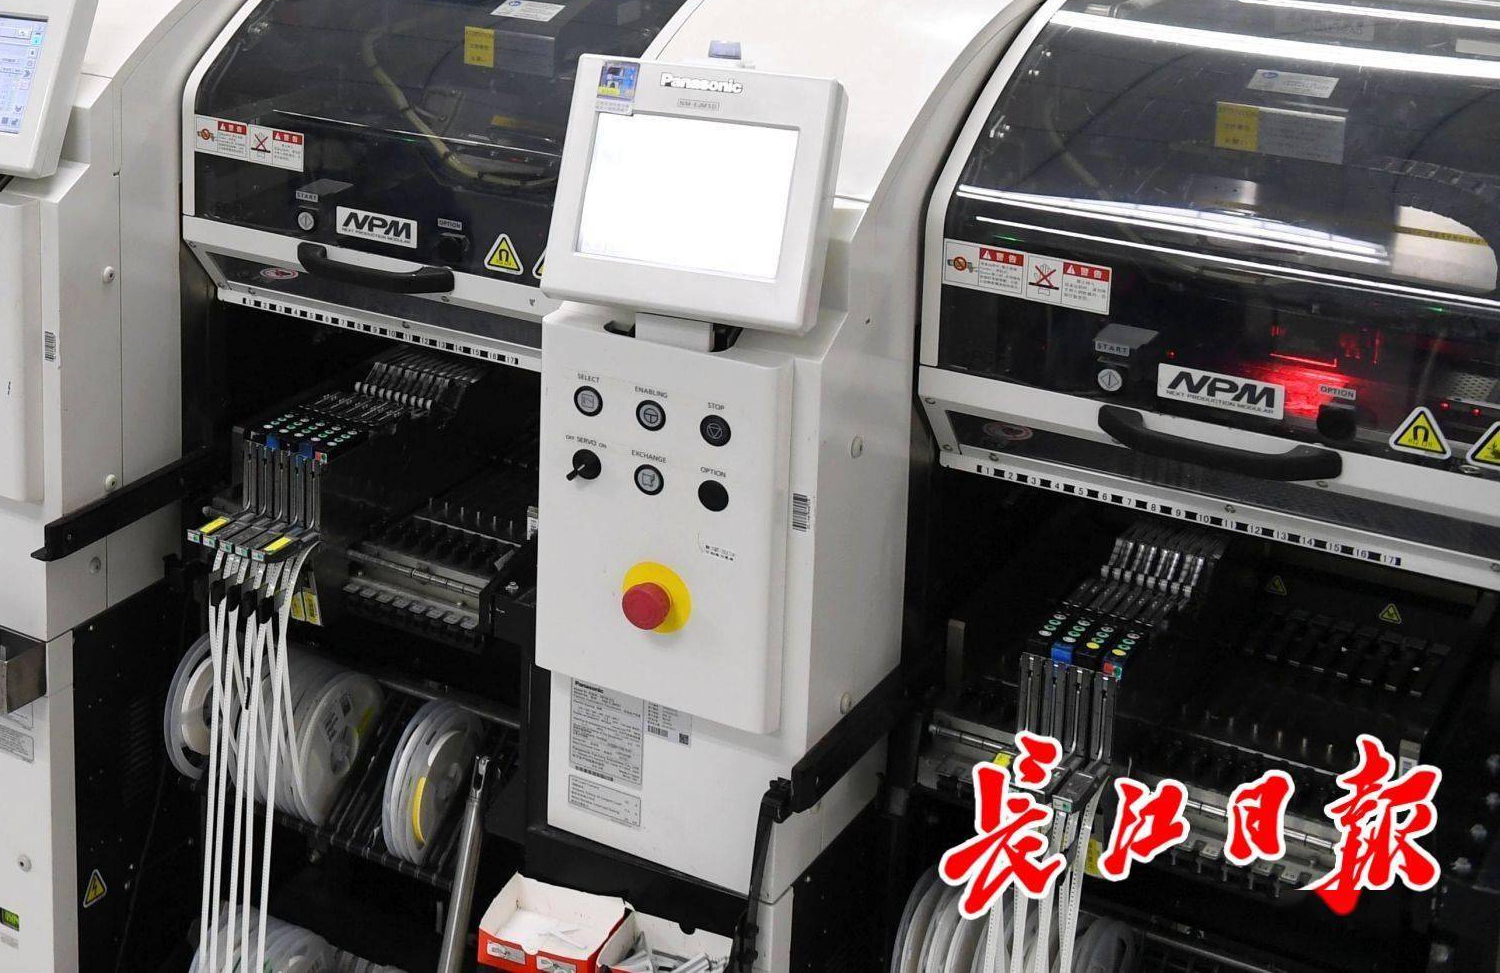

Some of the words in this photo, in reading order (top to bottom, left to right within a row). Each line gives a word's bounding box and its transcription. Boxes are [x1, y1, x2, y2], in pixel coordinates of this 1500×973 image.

[660, 72, 744, 94] Panasonic
[296, 192, 318, 201] START
[343, 212, 411, 240] NPM
[439, 220, 462, 229] OPTION
[996, 252, 1017, 264] 警告
[1080, 267, 1102, 278] 警告
[1096, 343, 1128, 354] START
[578, 373, 600, 384] SELECT
[634, 386, 668, 398] ENABLING
[1167, 371, 1275, 408] NPM
[1320, 386, 1355, 398] OPTION
[708, 402, 725, 411] STOP
[1166, 390, 1185, 398] NEXT
[1187, 393, 1236, 408] PRODUCTION
[1236, 402, 1274, 414] MODULAR
[576, 436, 598, 447] SERVO
[631, 450, 667, 464] EXCHANGE
[700, 466, 726, 478] OPTION
[1008, 472, 1013, 480] 2
[1031, 477, 1036, 485] 3
[1054, 482, 1060, 490] 4
[1127, 498, 1132, 506] 7
[1176, 509, 1181, 517] 9
[1200, 515, 1209, 523] 10
[1225, 520, 1234, 528] 11
[1251, 526, 1261, 534] 12
[1276, 532, 1286, 540] 13
[1302, 537, 1312, 546] 14
[1329, 543, 1340, 552] 15
[1355, 549, 1366, 558] 16
[1383, 555, 1393, 564] 17
